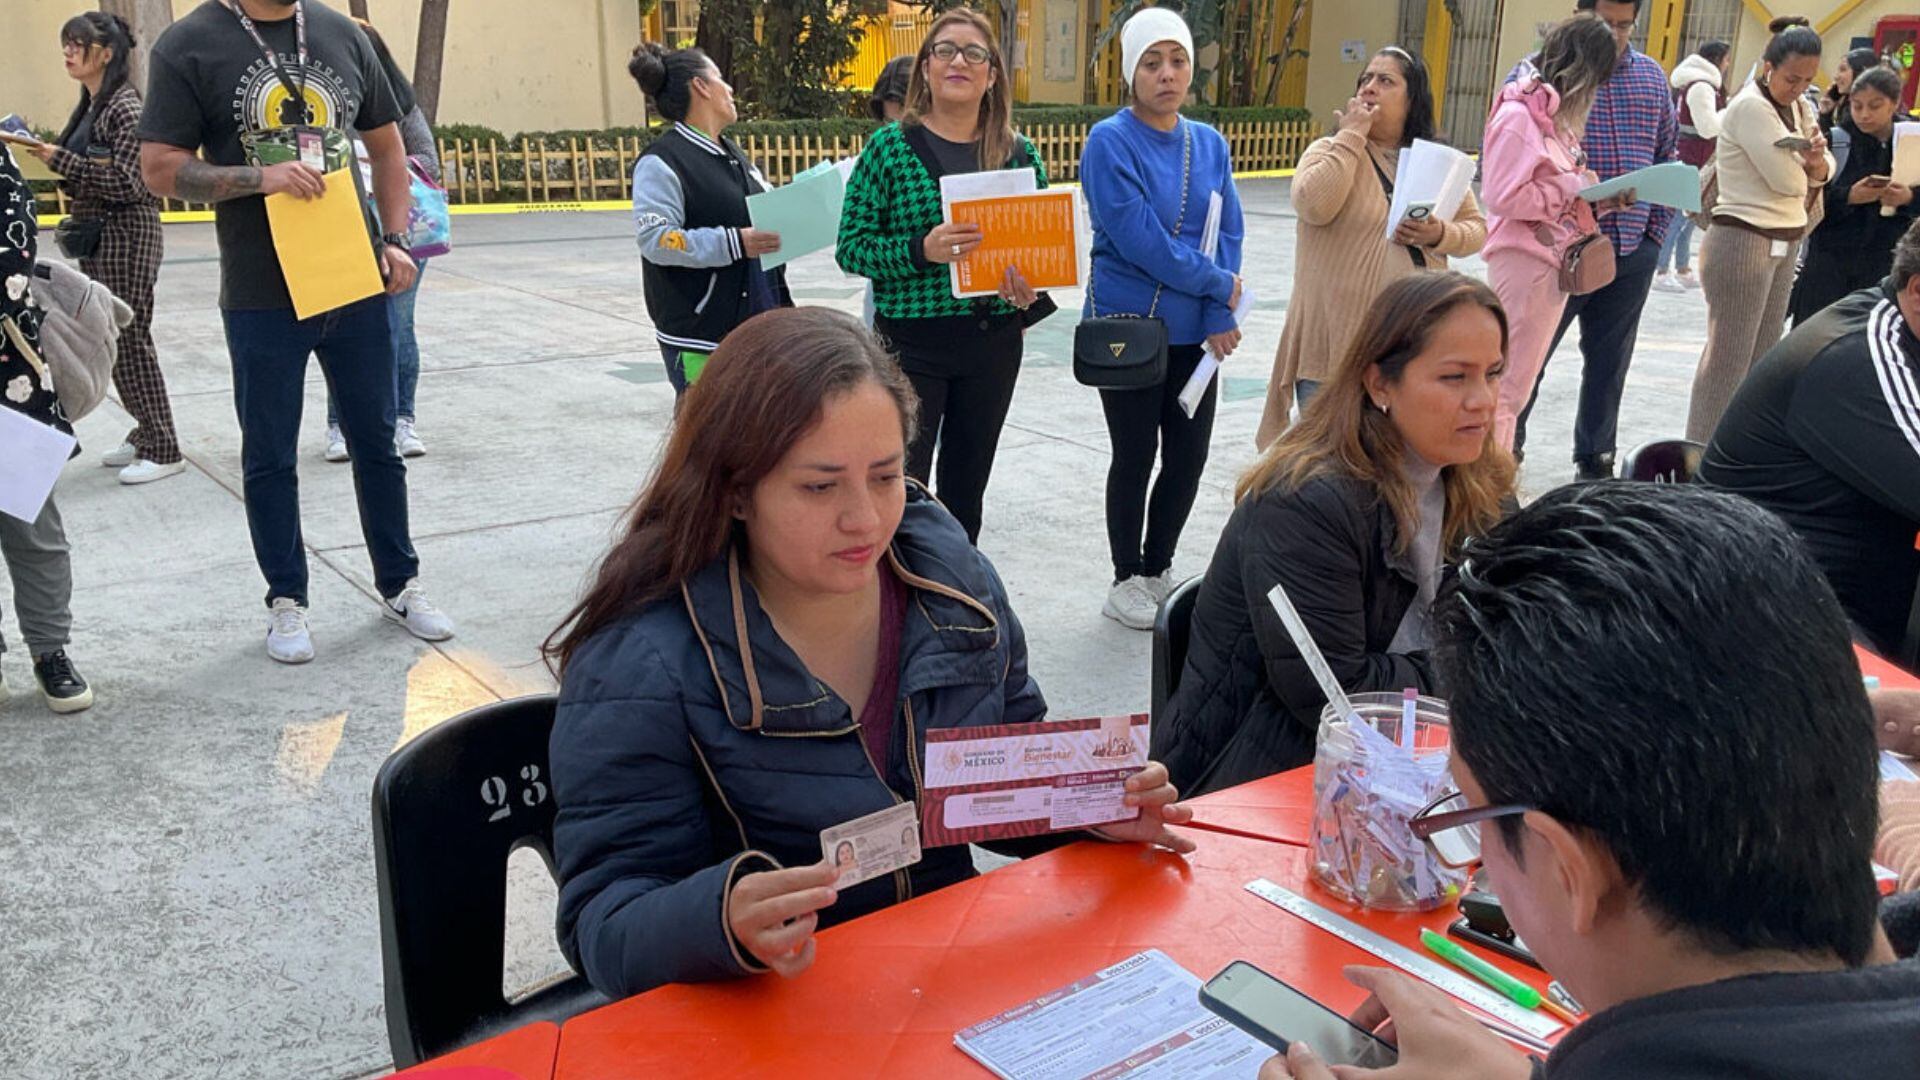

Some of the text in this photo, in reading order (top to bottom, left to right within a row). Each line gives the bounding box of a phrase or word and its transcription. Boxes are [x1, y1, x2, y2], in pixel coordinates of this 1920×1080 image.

[963, 755, 1005, 767] MÉXICO
[1024, 751, 1072, 762] Bienestar
[481, 764, 547, 822] 23
